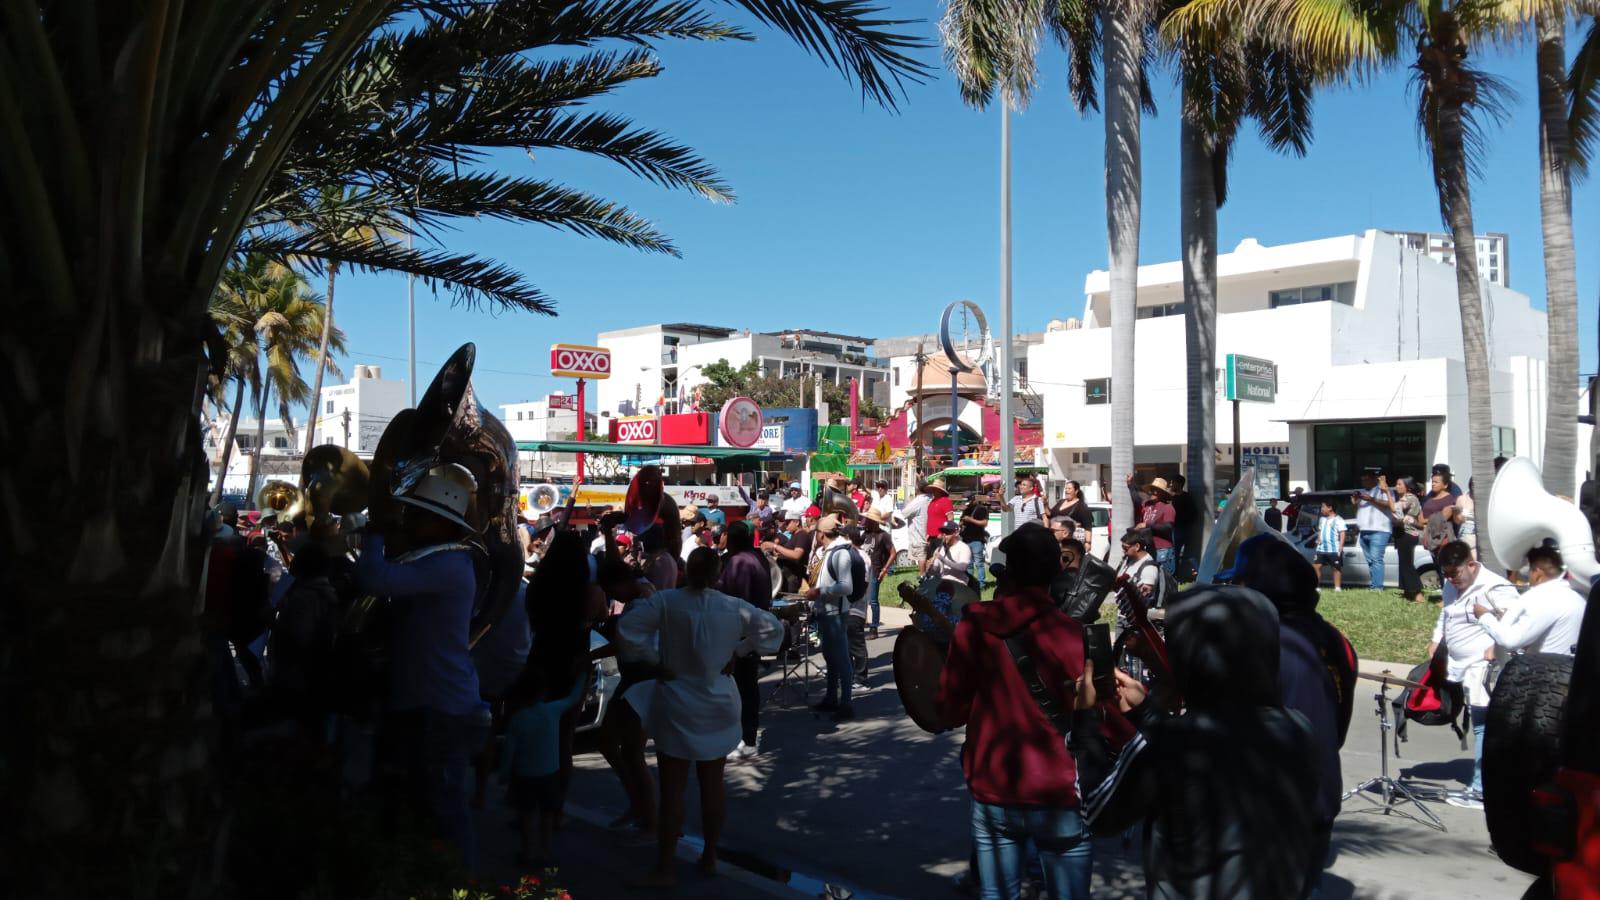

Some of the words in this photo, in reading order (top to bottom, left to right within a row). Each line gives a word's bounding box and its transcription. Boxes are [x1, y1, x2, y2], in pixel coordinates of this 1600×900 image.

[558, 351, 609, 371] OXXO
[1247, 383, 1271, 397] National
[618, 420, 654, 443] OXXO
